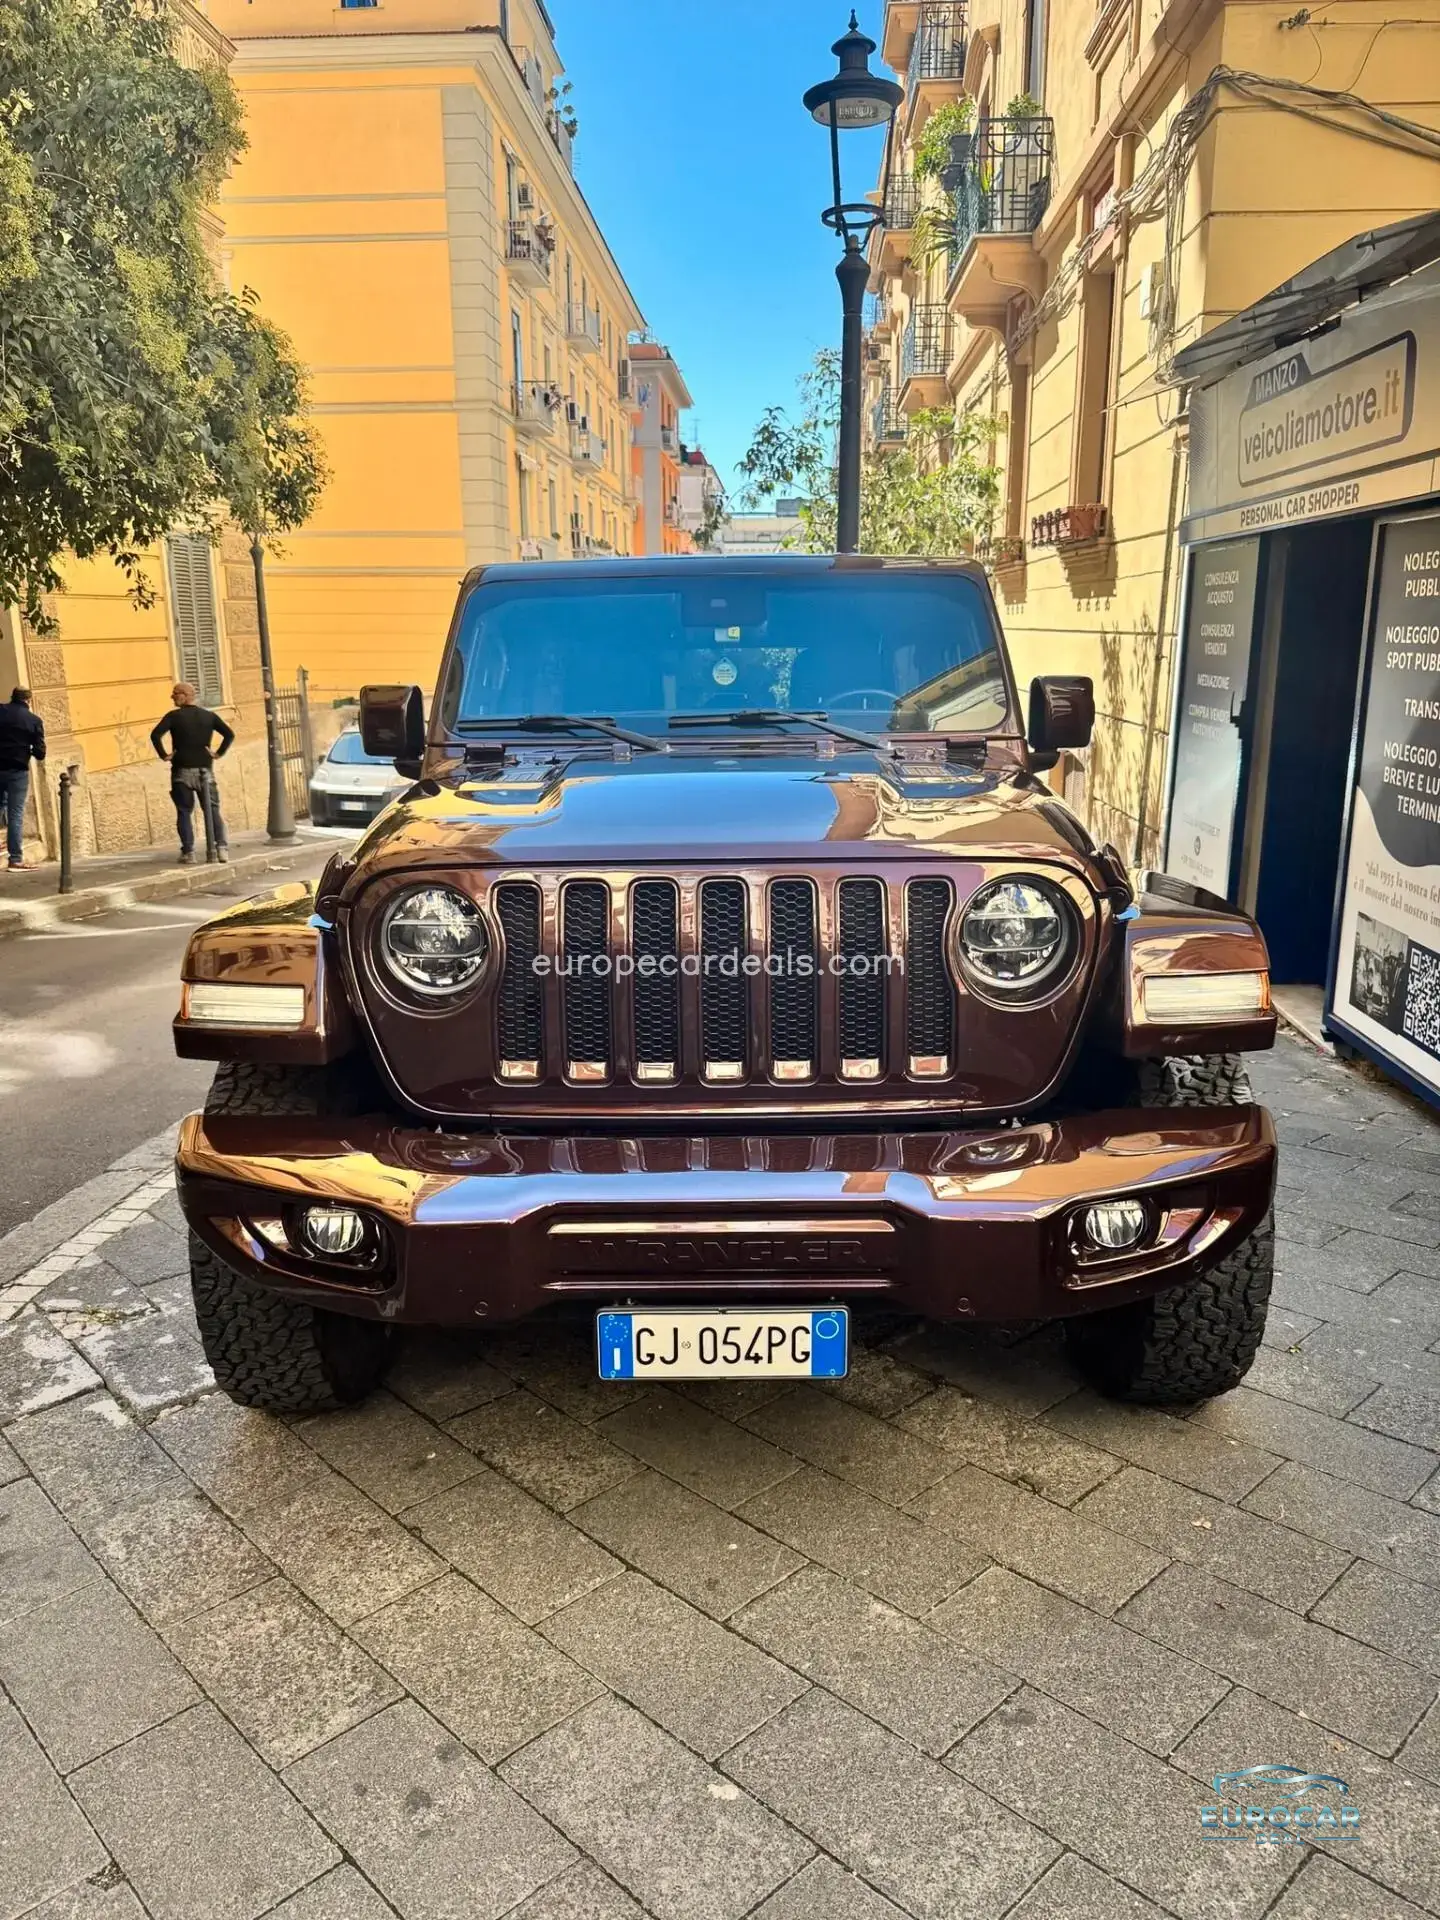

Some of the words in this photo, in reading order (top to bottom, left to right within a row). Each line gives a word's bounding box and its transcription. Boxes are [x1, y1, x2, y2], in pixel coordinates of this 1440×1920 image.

[1255, 358, 1298, 400] MANZO
[1244, 369, 1401, 465] veicoliamotore.it
[1240, 503, 1284, 528] PERSONAL
[1286, 495, 1306, 518] CAR
[1308, 482, 1360, 513] SHOPPER
[1404, 550, 1440, 572] NOLEG
[1204, 569, 1240, 587] CONSULENZA
[1405, 577, 1439, 598] PUBBL
[1200, 623, 1235, 638] CONSULENZA
[1385, 625, 1440, 645] NOLEGGIO
[1386, 651, 1413, 670] SPOT
[1404, 698, 1440, 720] TRANS
[1383, 740, 1437, 768] NOLEGGIO
[1383, 766, 1416, 790] BREVE
[1417, 774, 1425, 792] E
[1404, 879, 1429, 899] vostra
[1403, 903, 1429, 922] nostro
[635, 1326, 679, 1365] GJ
[699, 1325, 811, 1365] 054PG
